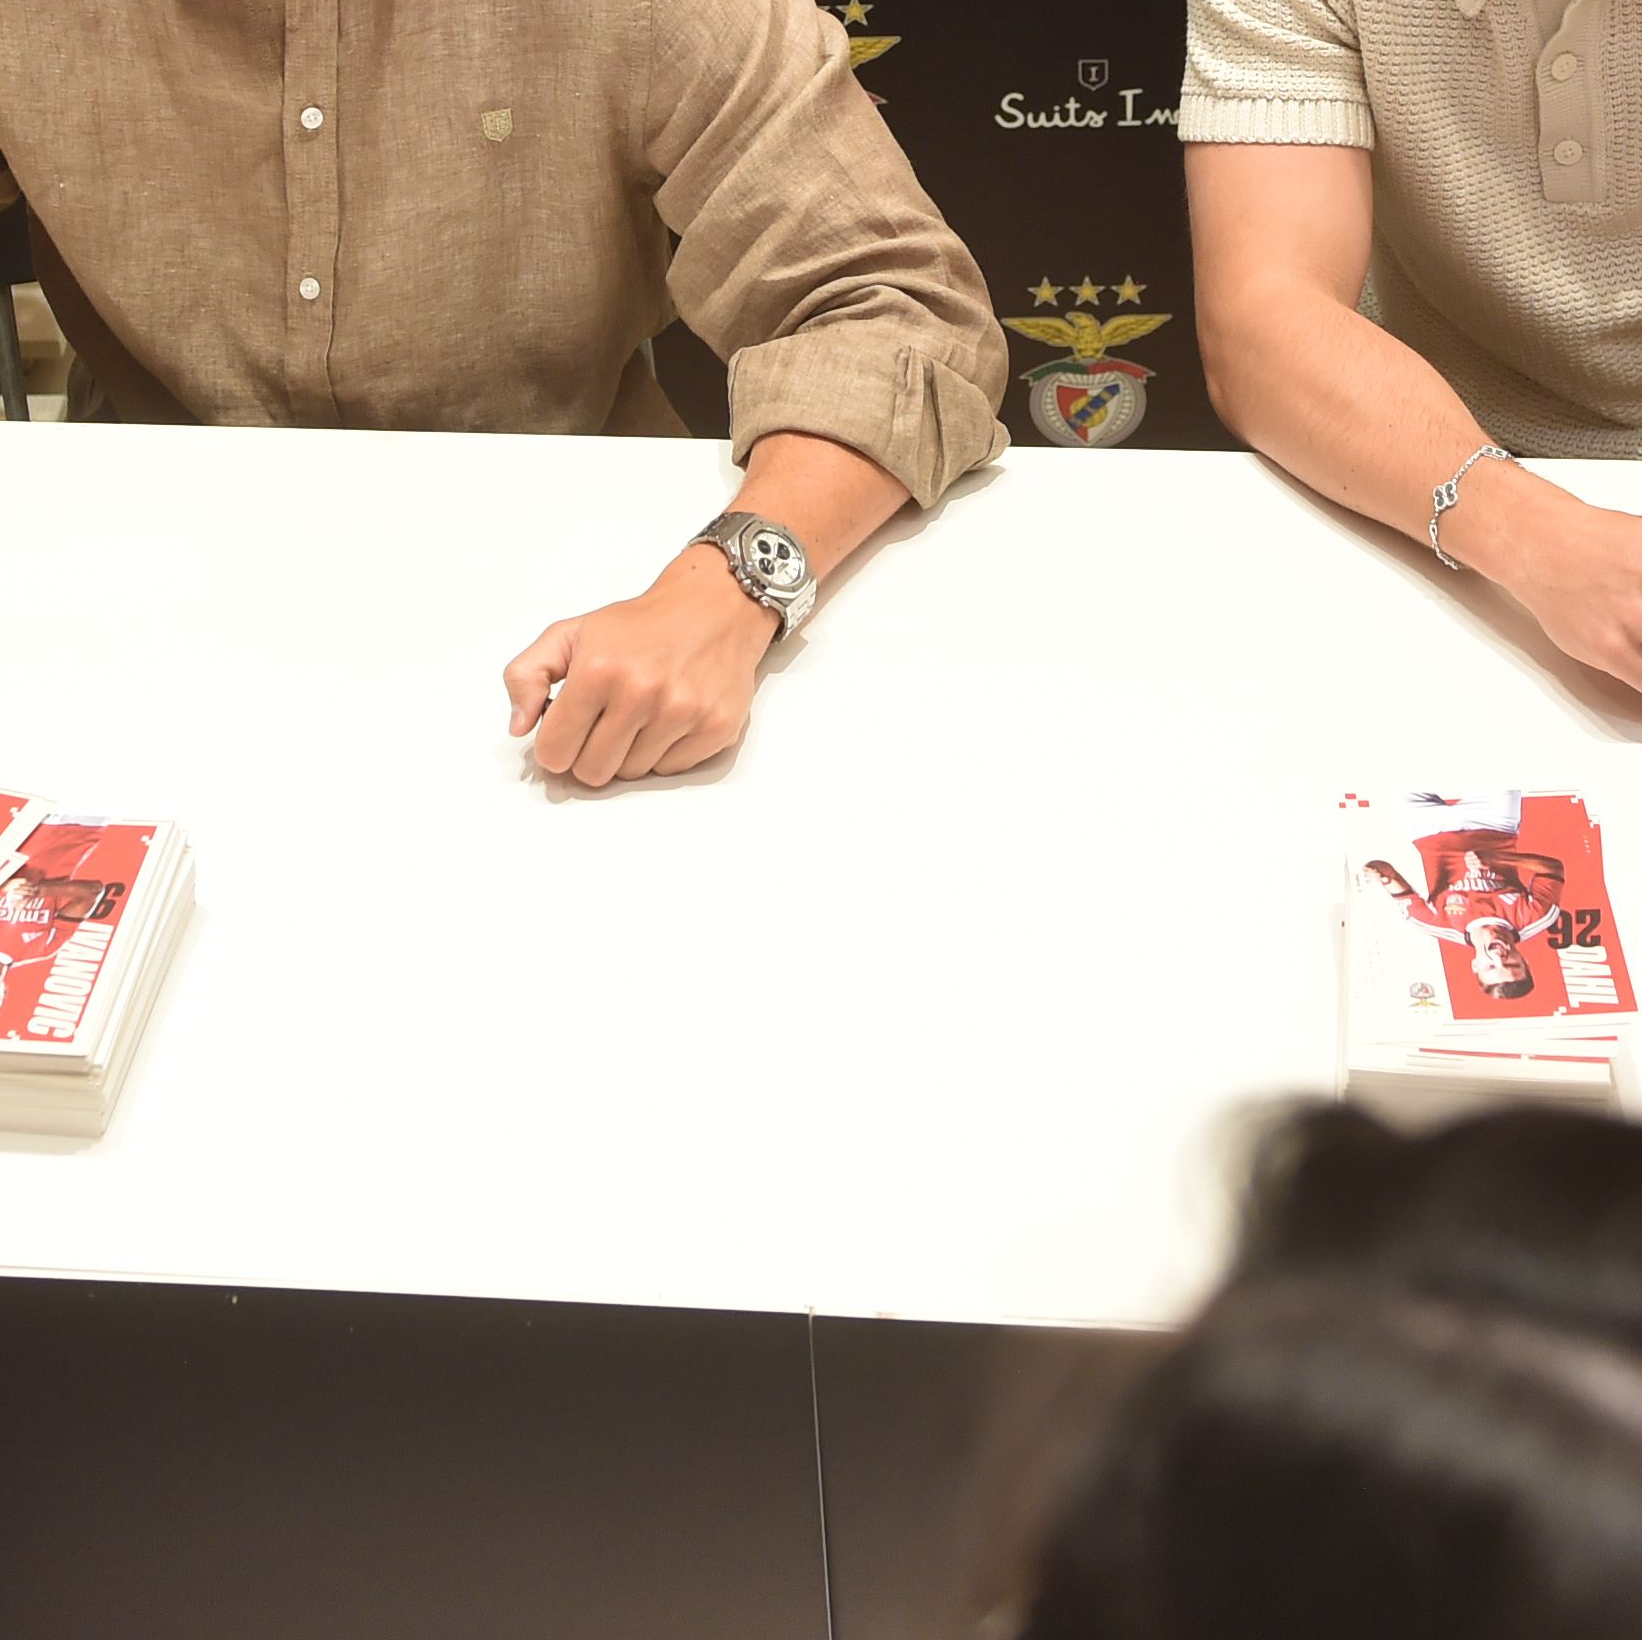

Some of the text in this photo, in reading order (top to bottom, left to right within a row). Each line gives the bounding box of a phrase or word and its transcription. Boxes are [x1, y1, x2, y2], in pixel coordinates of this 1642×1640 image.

[994, 88, 1179, 129] Suits In
[27, 921, 114, 1039] IVANOVIC
[1558, 943, 1620, 1009] DAHL
